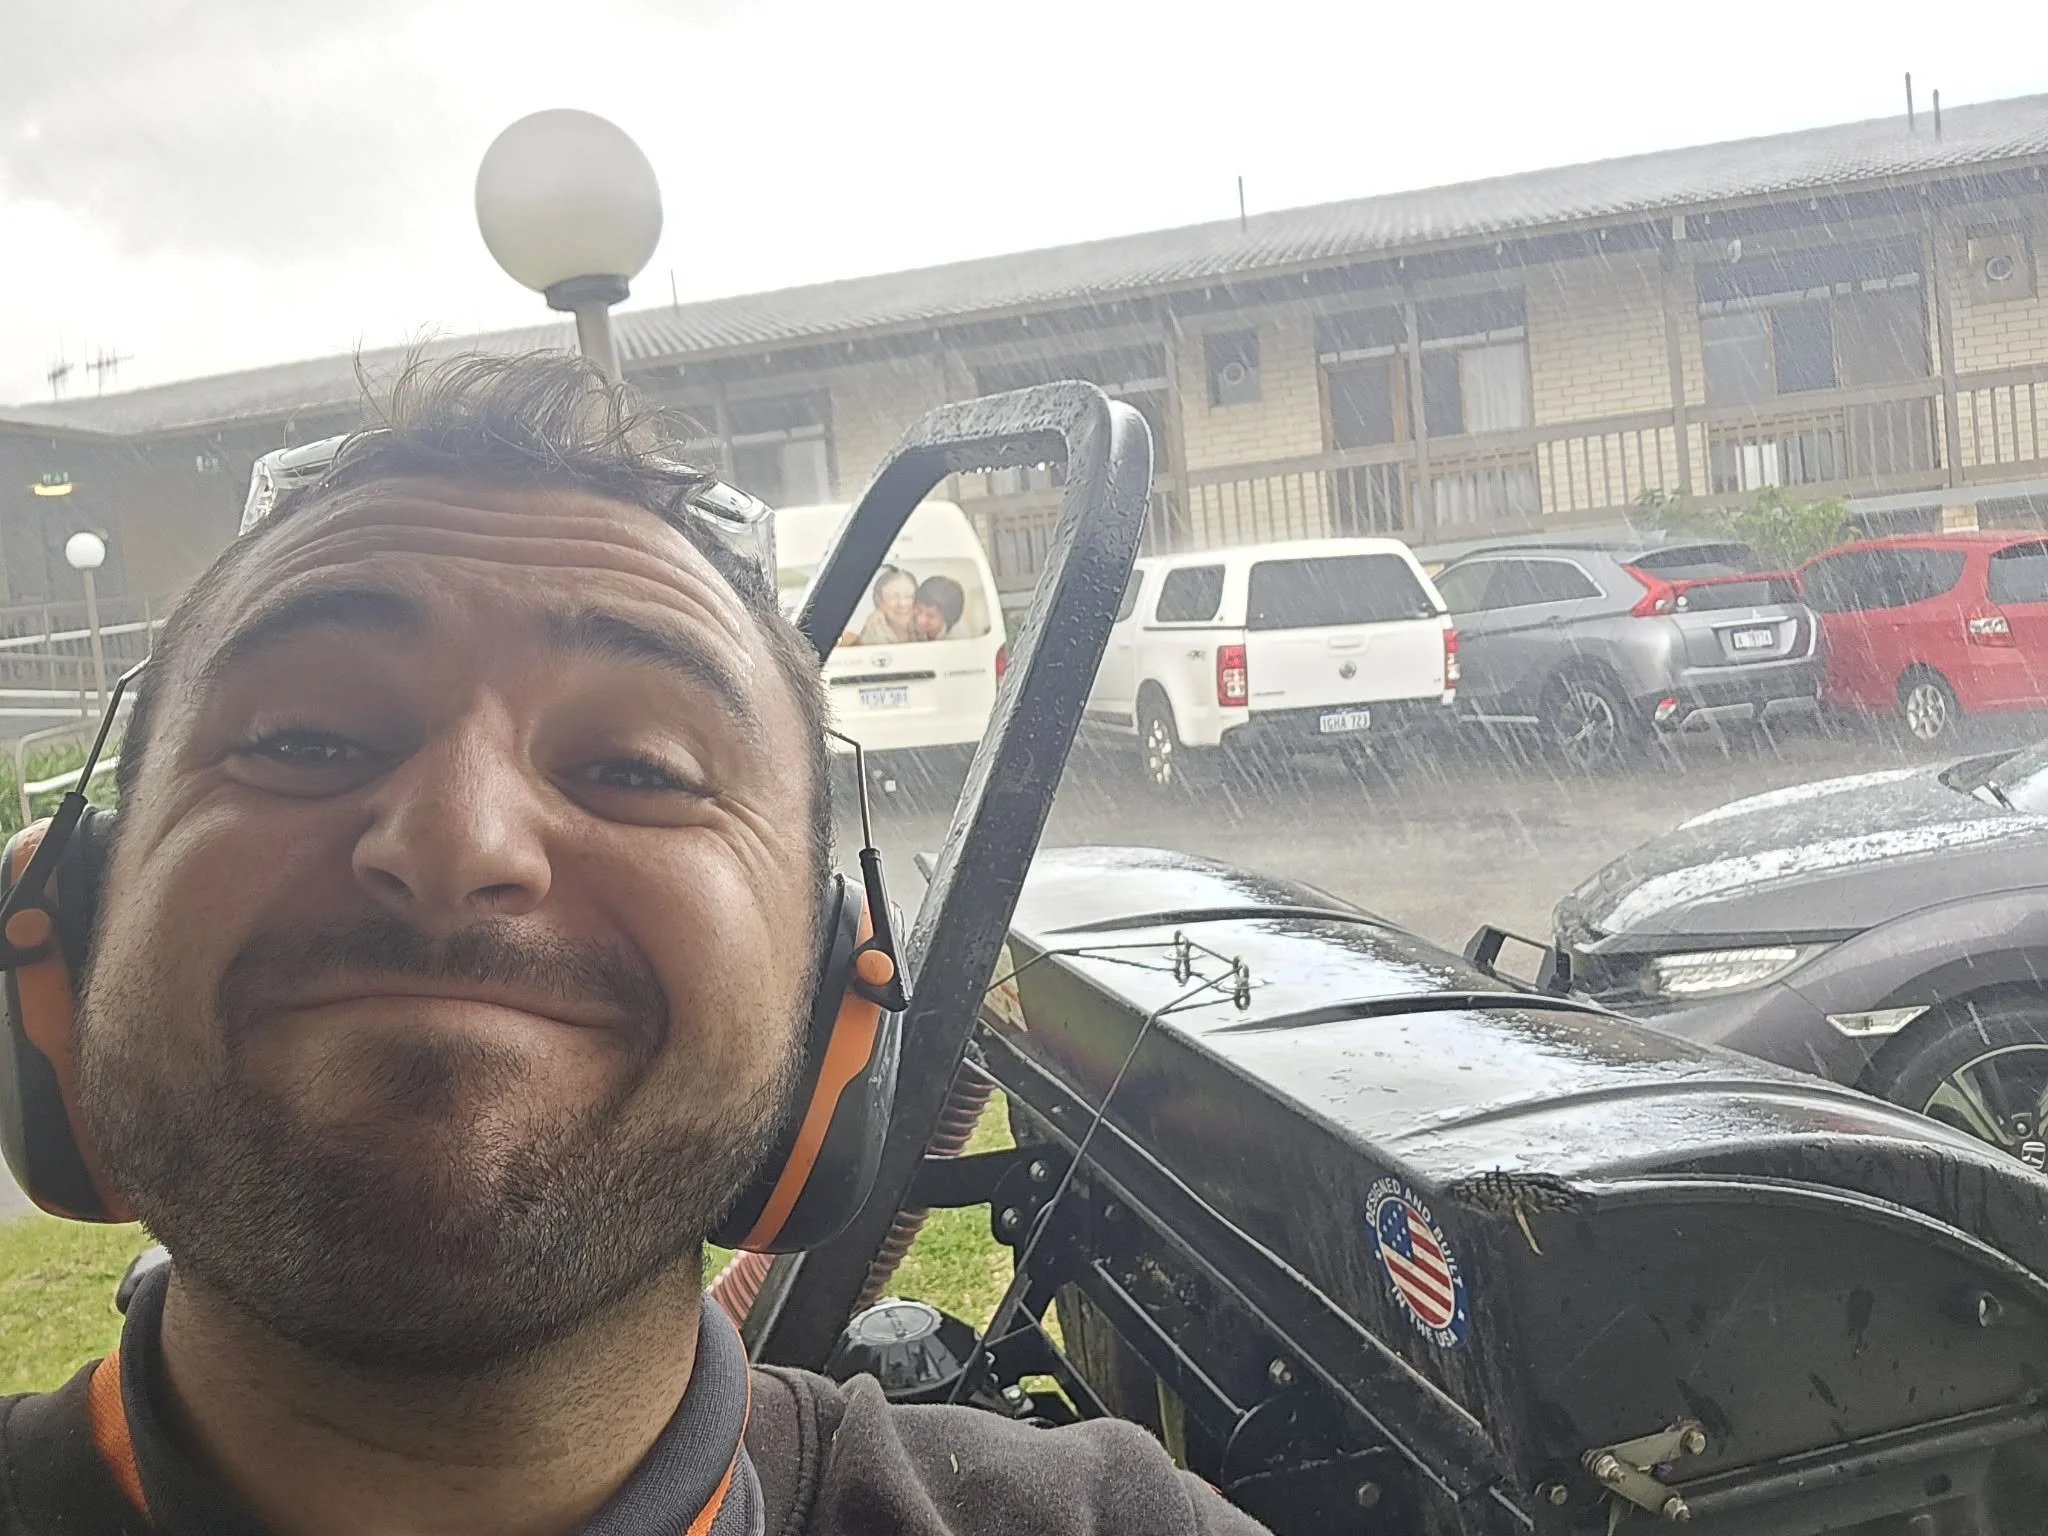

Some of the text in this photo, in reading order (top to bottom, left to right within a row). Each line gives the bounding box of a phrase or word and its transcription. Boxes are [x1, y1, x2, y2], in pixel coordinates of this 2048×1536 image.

[1365, 1177, 1463, 1288] DESIGNED AND BUILT
[1409, 1308, 1434, 1344] THE
[1434, 1327, 1458, 1347] USA
